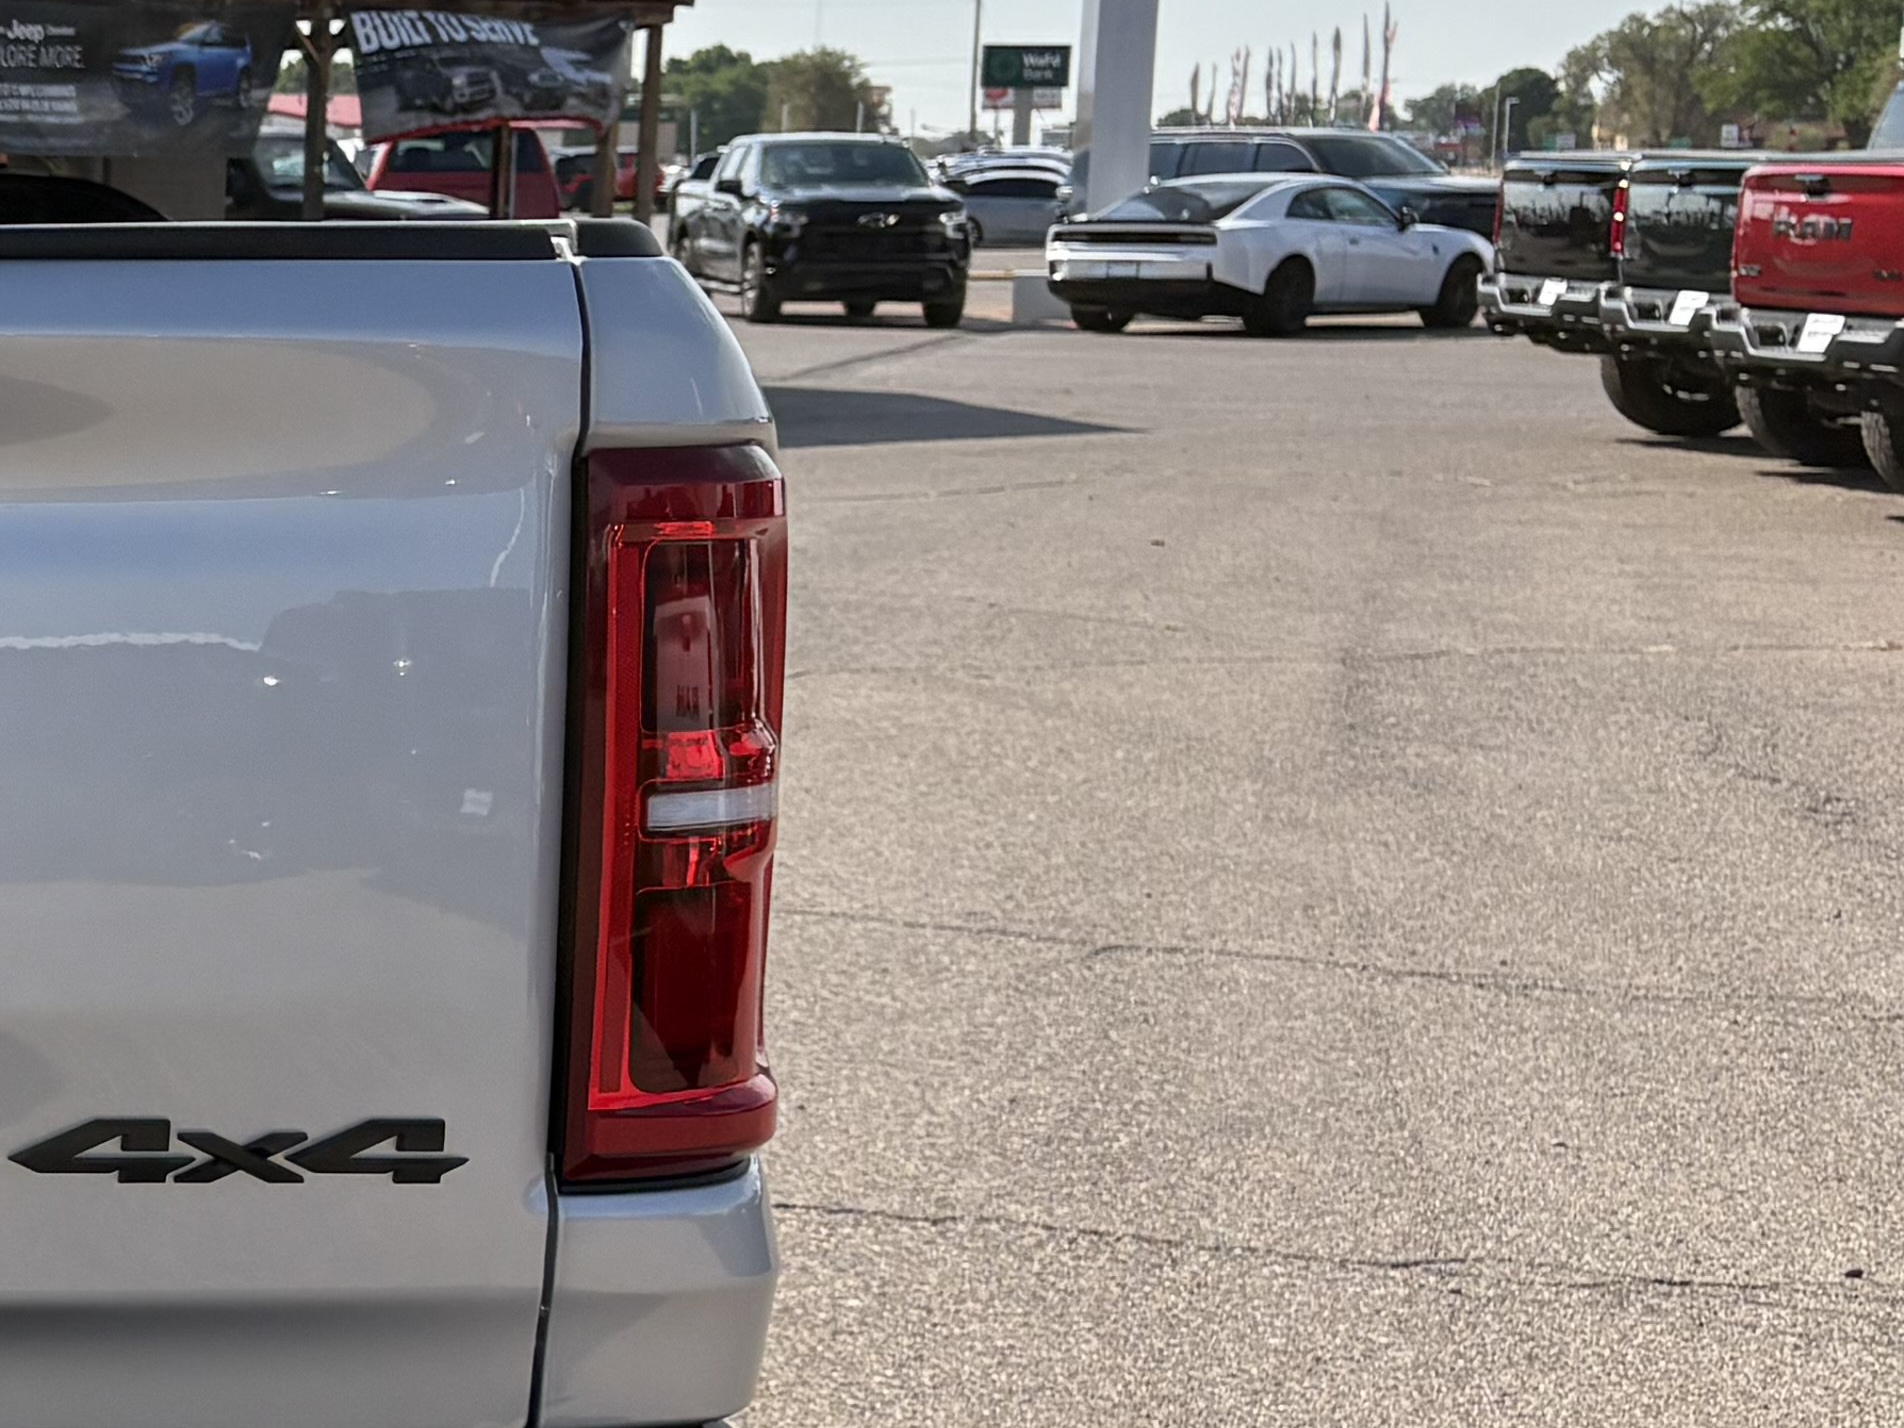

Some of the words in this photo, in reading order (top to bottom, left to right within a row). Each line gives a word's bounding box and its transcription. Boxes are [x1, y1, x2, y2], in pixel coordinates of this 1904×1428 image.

[350, 10, 433, 54] BUILT
[422, 11, 469, 43] TO
[461, 14, 540, 46] SERVE
[7, 1118, 470, 1183] 4x4
